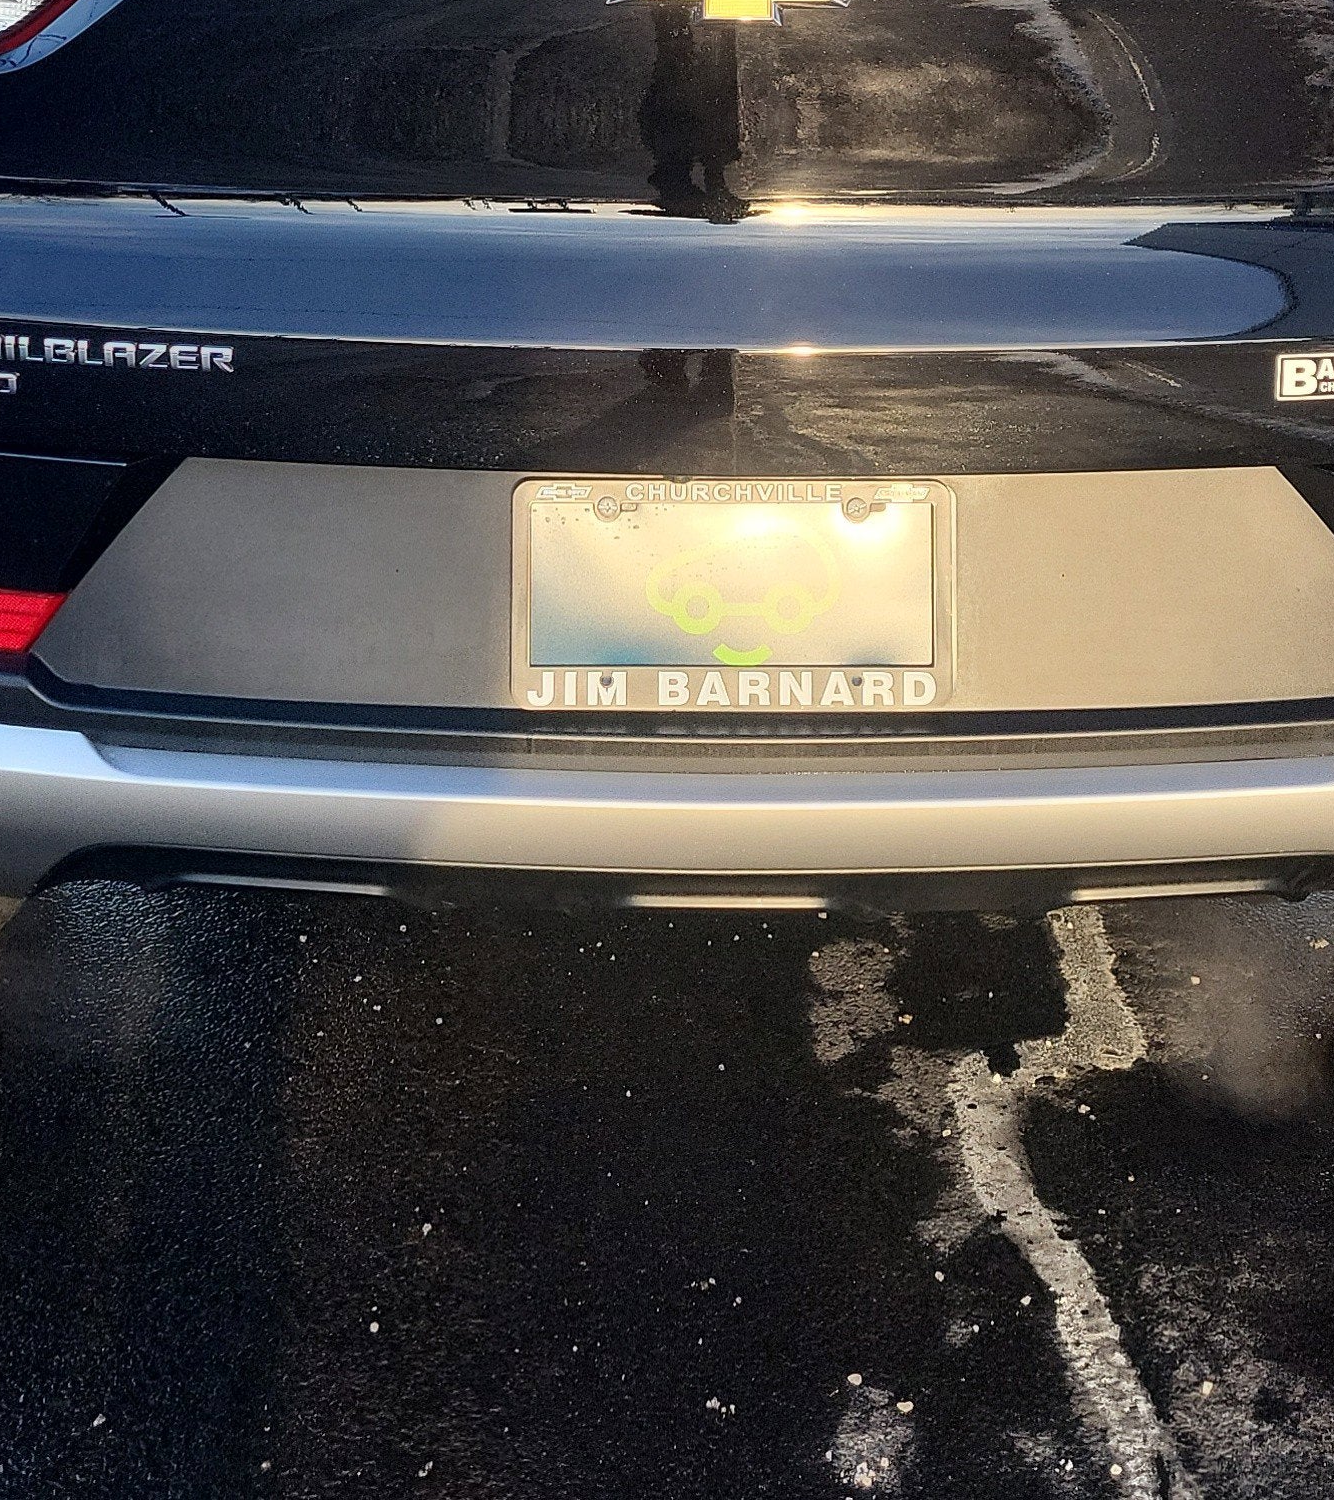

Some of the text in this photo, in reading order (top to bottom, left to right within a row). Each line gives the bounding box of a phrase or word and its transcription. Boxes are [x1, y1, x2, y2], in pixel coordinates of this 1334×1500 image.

[624, 482, 844, 503] CHURCHVILLE
[526, 670, 938, 707] JIM BARNARD
